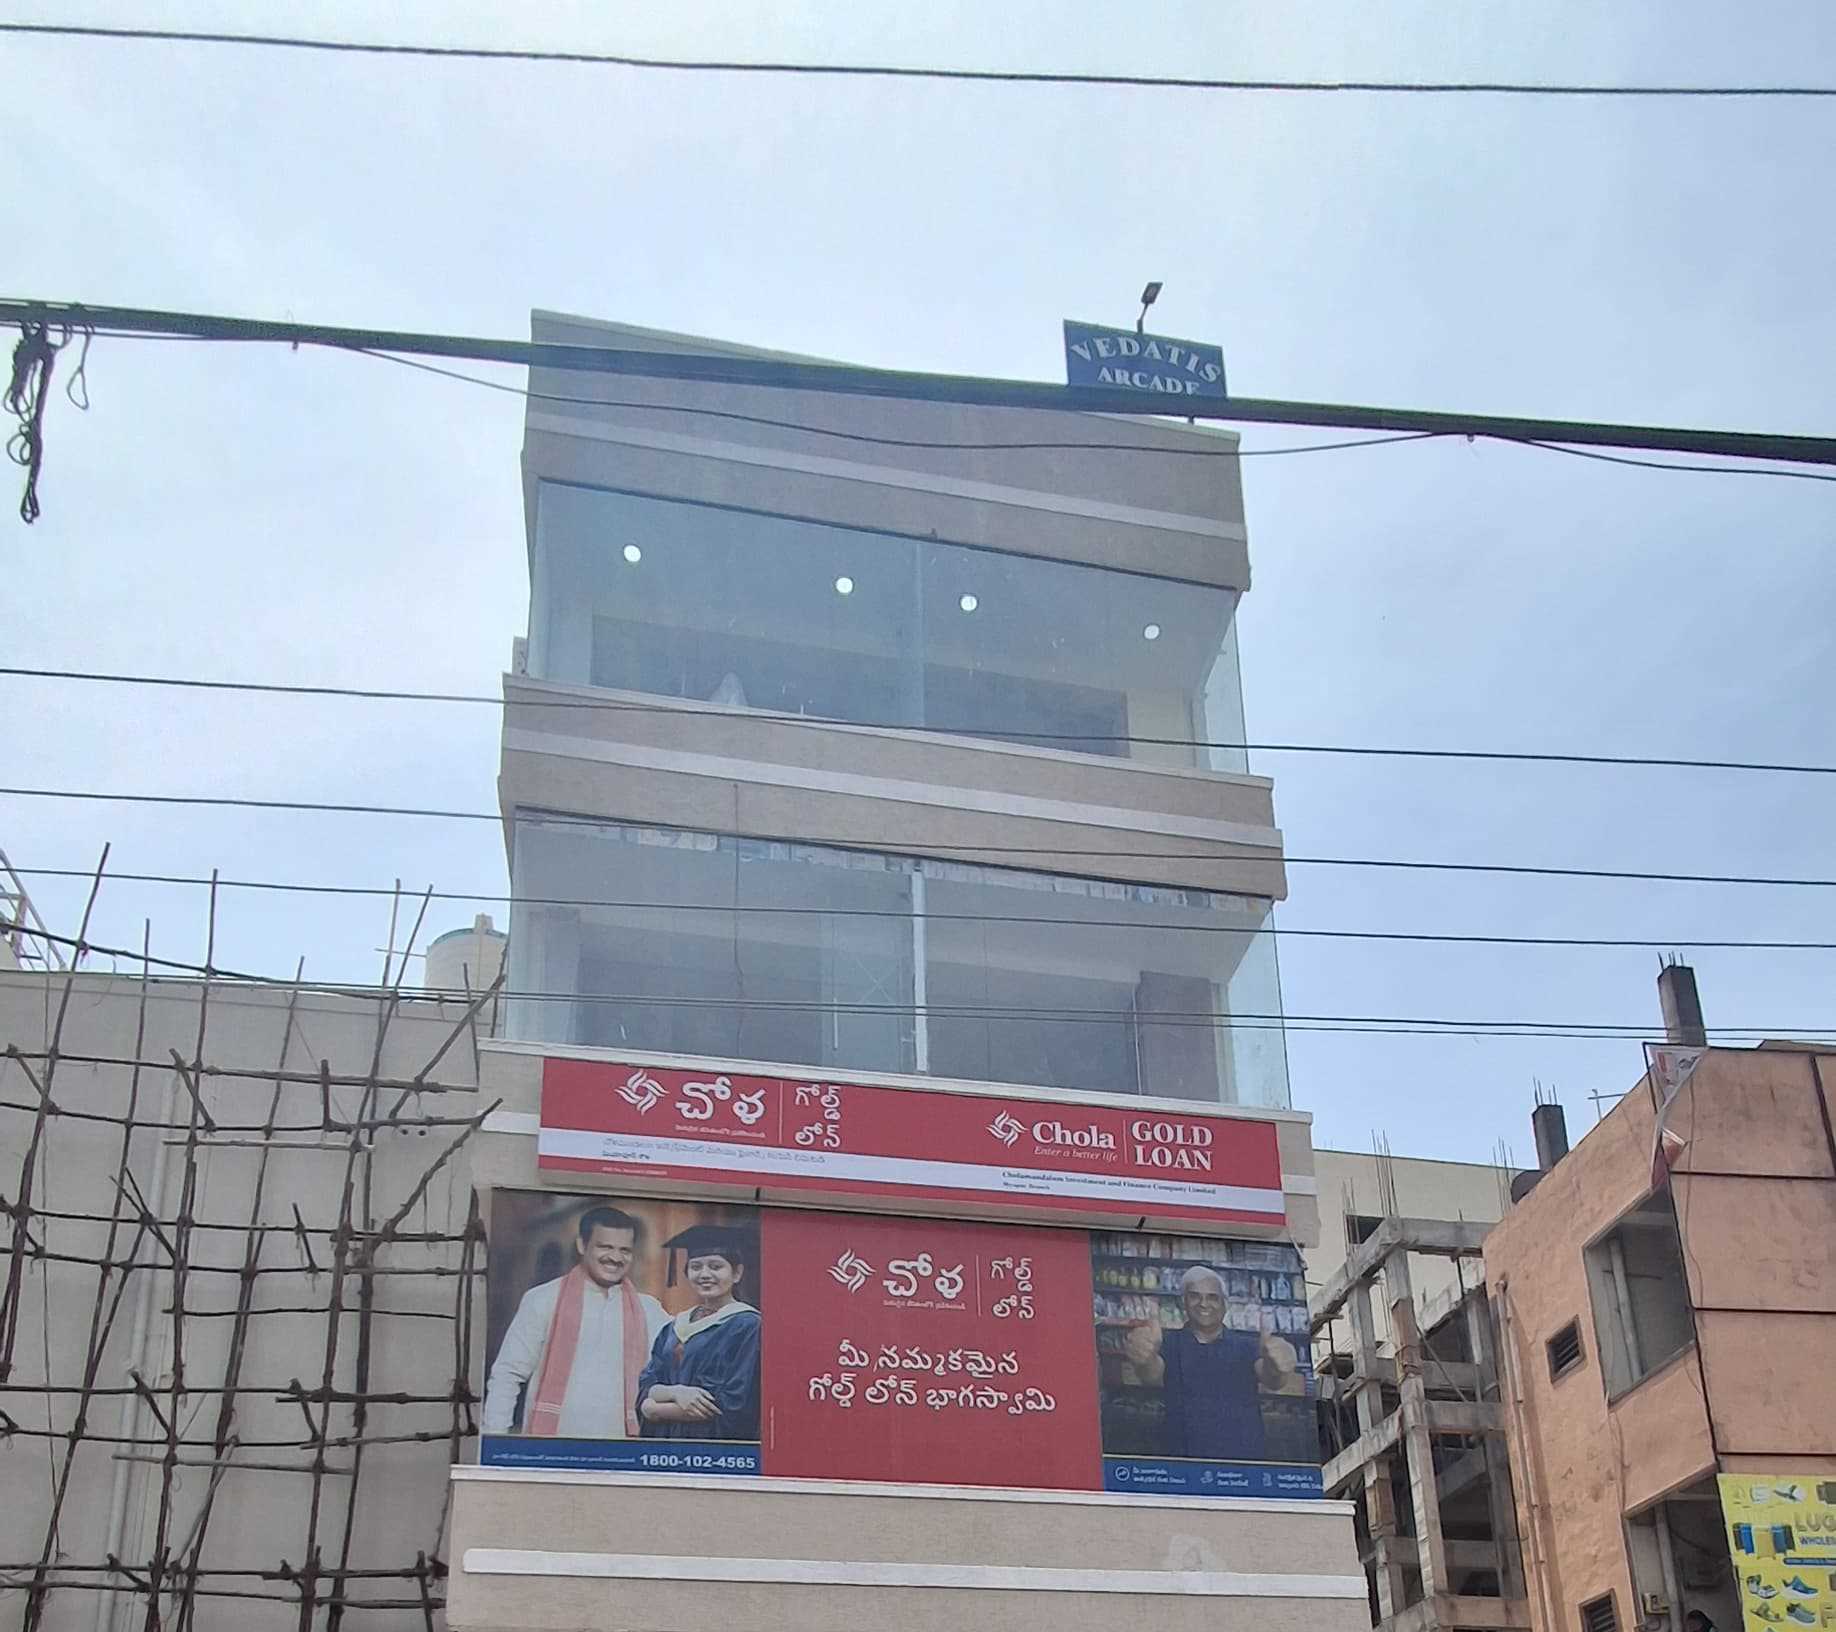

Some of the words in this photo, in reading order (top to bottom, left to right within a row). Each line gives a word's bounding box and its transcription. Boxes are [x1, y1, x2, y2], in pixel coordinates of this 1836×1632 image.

[1071, 336, 1221, 383] VEDATIS
[1098, 367, 1200, 395] ARCADE
[795, 1122, 841, 1148] లోన్
[1032, 1121, 1116, 1150] Chola
[1131, 1120, 1213, 1147] GOLD
[1034, 1147, 1061, 1156] Enter
[1072, 1150, 1099, 1160] better
[1102, 1151, 1118, 1163] life
[1134, 1145, 1213, 1171] LOAN
[992, 1295, 1034, 1320] లోన్
[838, 1340, 870, 1368] మీ
[877, 1344, 1019, 1378] నమ్మకమైన
[865, 1376, 918, 1406] లోన్
[925, 1384, 1056, 1415] భాగస్వామి
[639, 1454, 756, 1468] 1800-102-4565
